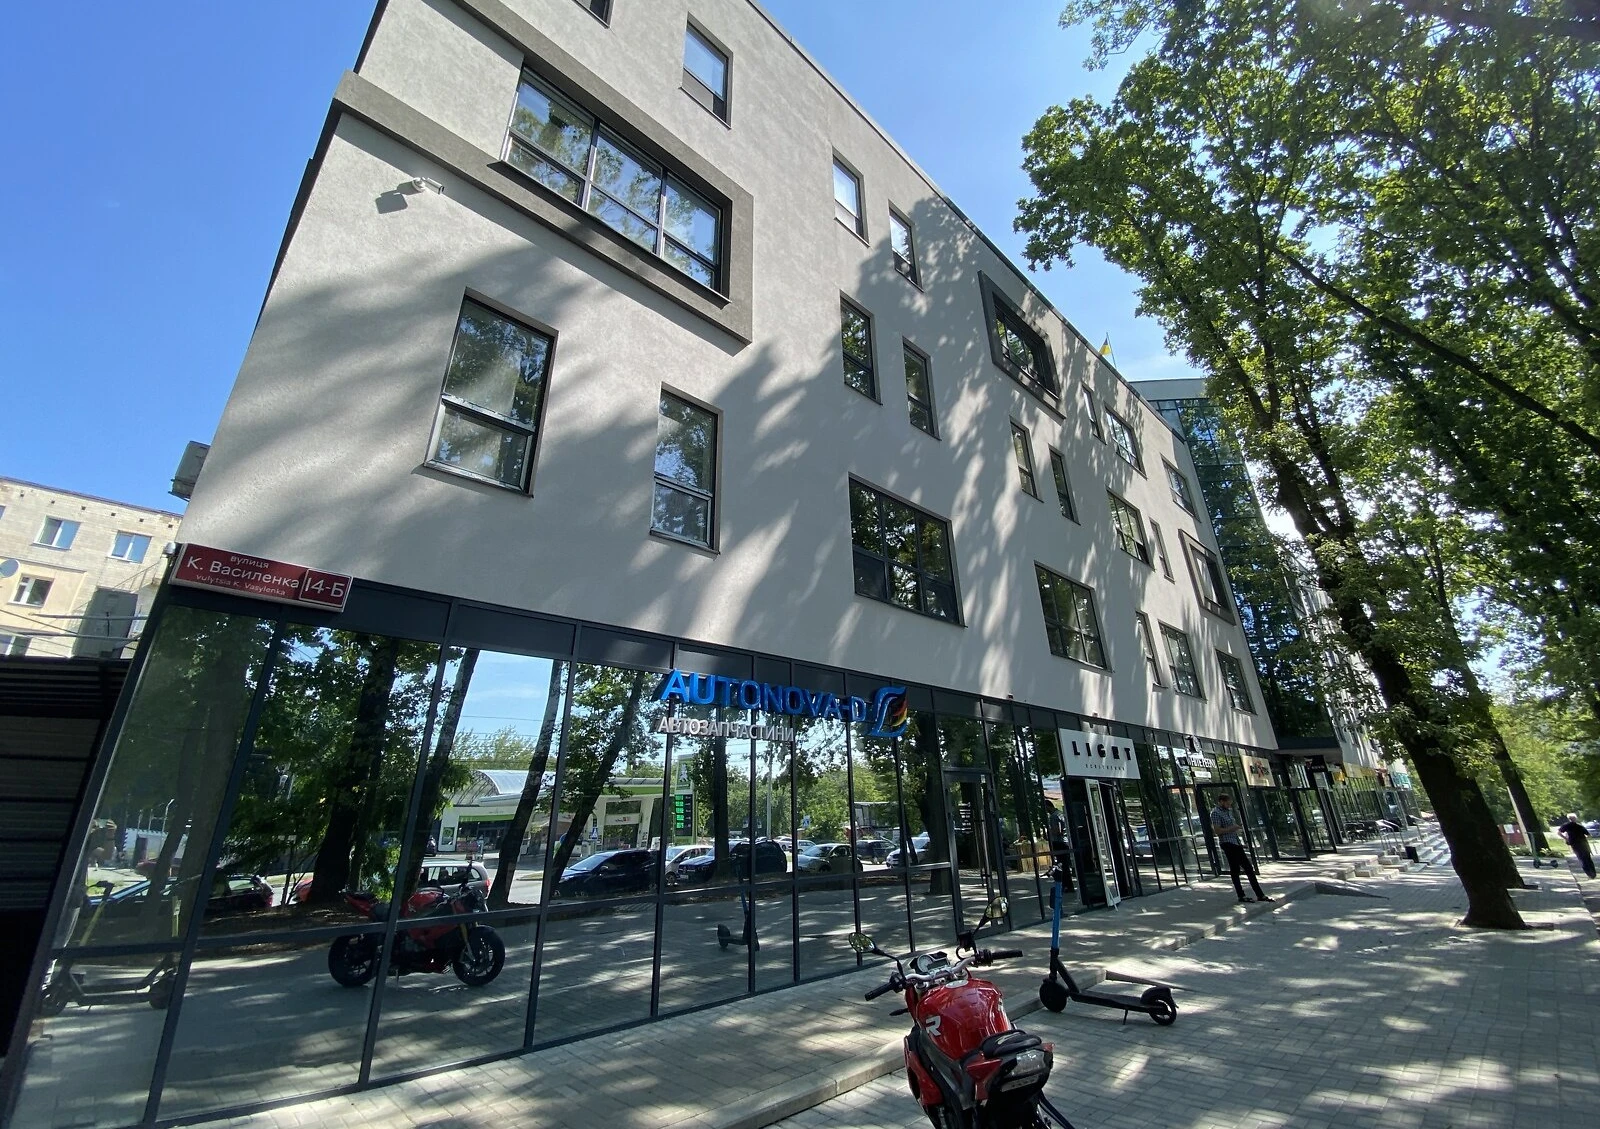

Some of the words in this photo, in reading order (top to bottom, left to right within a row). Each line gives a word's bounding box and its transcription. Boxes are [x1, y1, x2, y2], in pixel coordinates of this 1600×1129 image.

[187, 556, 204, 571] К.
[209, 561, 300, 589] Василенка
[230, 555, 270, 569] вулиця
[196, 574, 231, 587] vulytsia
[245, 583, 286, 597] Vasylenka
[304, 577, 345, 598] 14-Б
[657, 668, 867, 722] AUTONOVA-D
[656, 716, 795, 742] АВТОЗАПЧАСТИНИ
[925, 1015, 942, 1036] R
